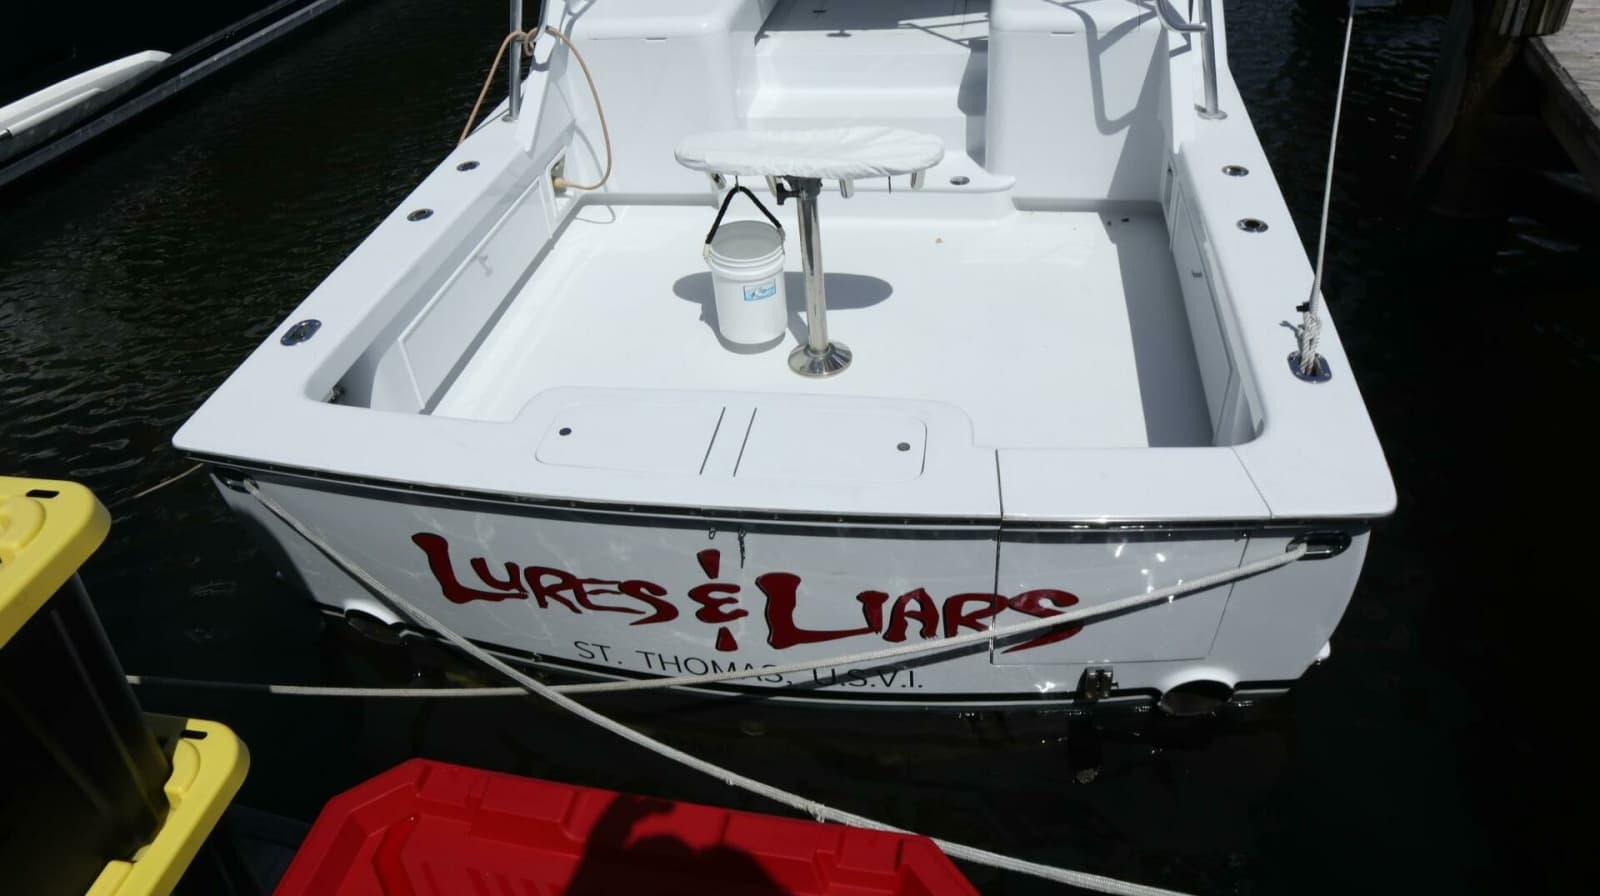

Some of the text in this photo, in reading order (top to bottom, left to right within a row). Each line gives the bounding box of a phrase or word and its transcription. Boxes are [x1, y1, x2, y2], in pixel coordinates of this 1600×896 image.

[411, 532, 1085, 653] LURES & LIARS
[573, 640, 623, 665] ST.
[812, 667, 923, 688] U.S.V.I.
